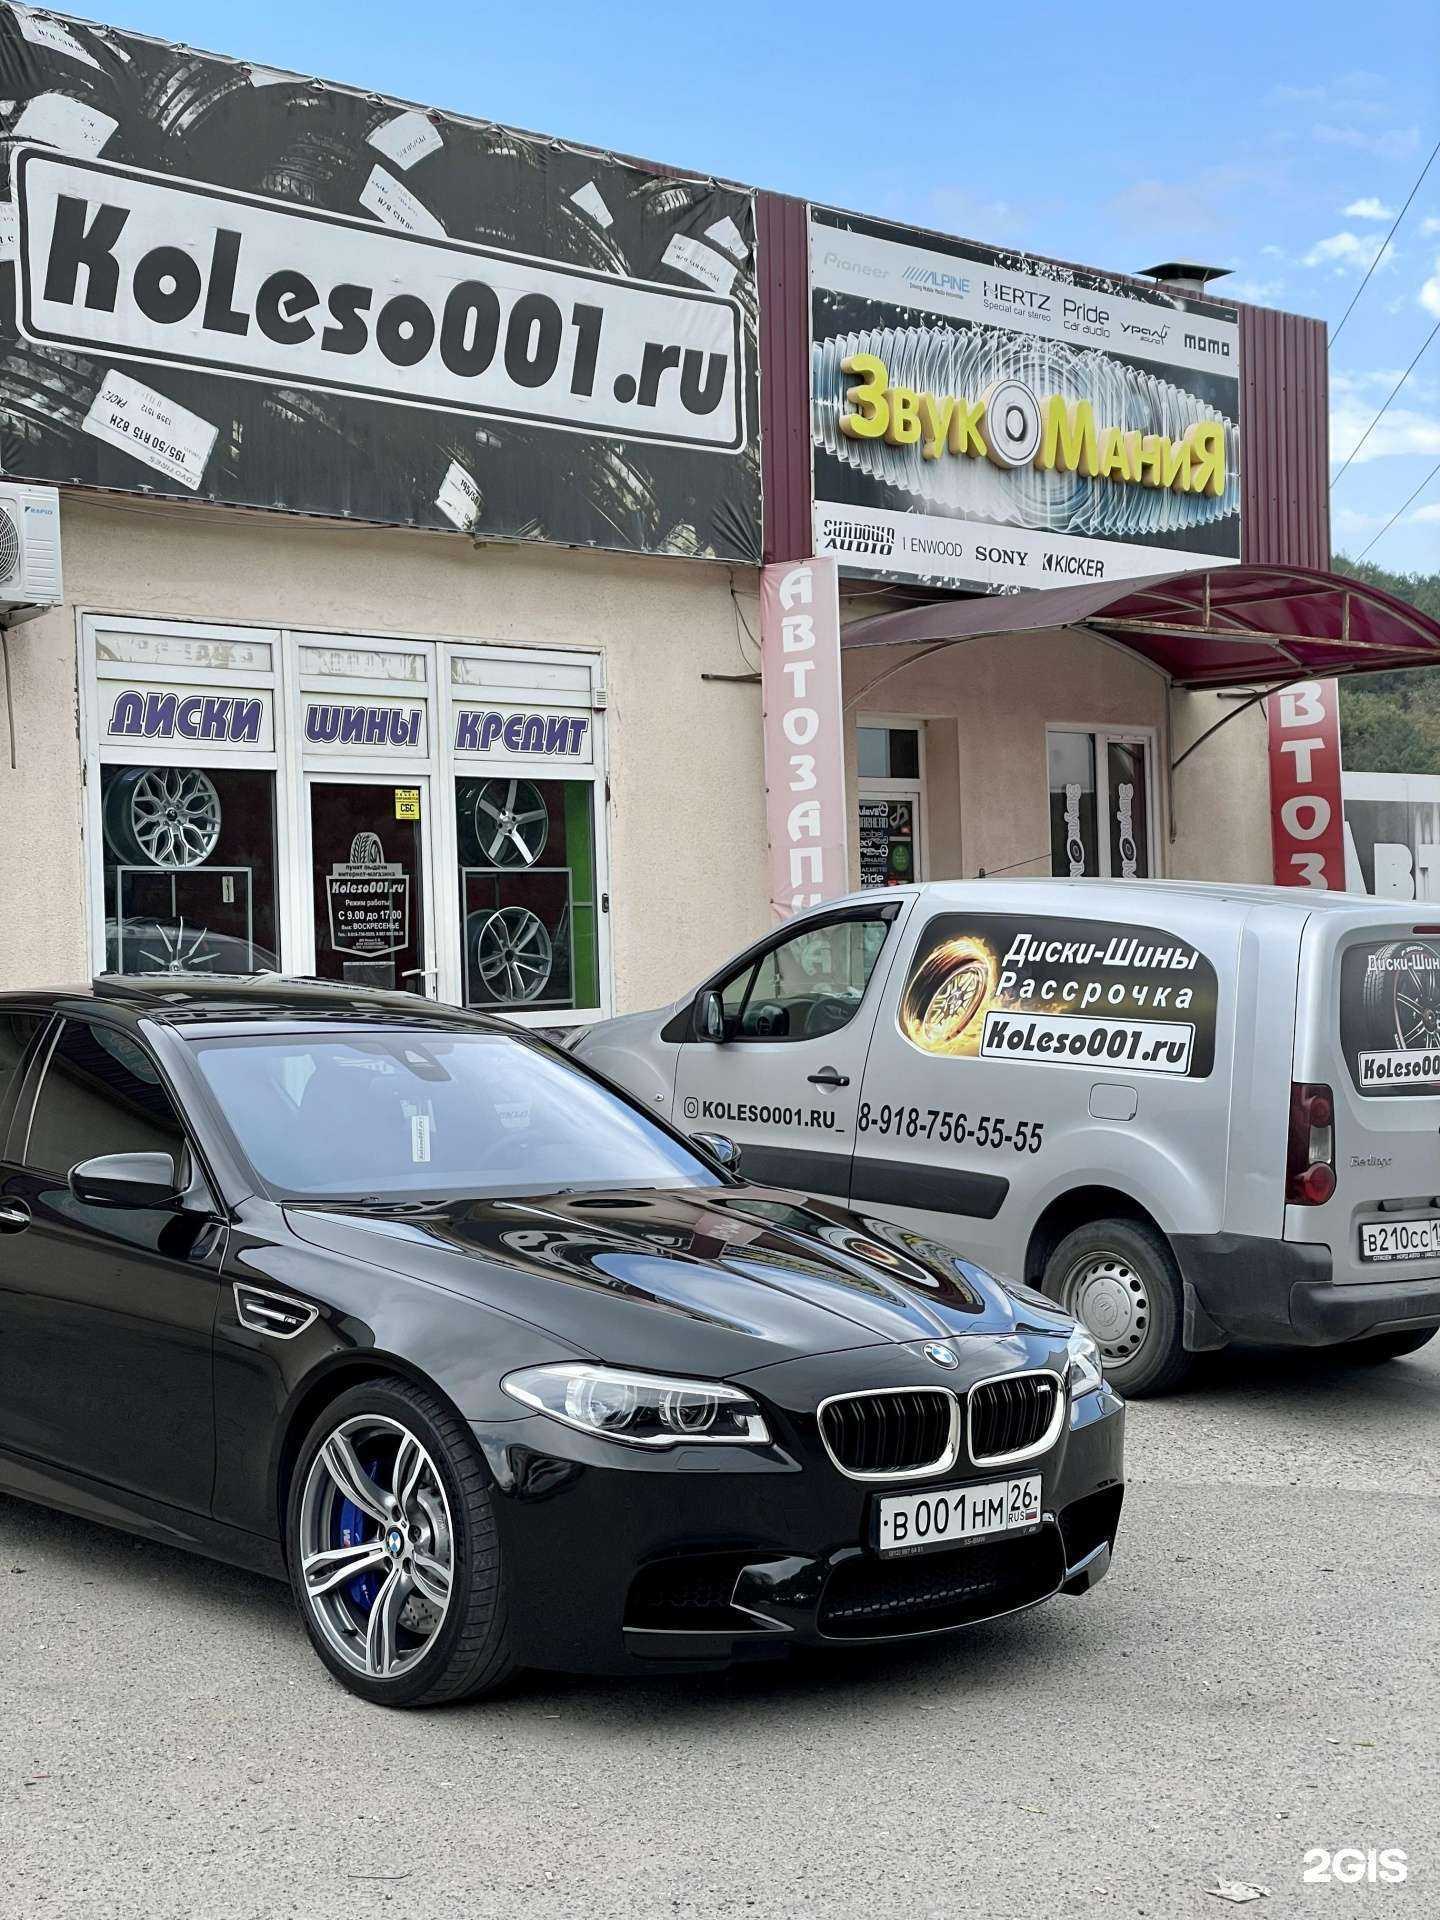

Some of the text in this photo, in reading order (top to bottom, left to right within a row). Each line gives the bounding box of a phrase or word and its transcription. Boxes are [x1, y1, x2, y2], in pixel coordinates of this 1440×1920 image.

[824, 252, 891, 279] Pioneer
[921, 269, 971, 294] ALPINE
[983, 280, 1051, 311] HERTZ
[983, 299, 1051, 321] Special car stereo
[1063, 298, 1110, 325] Pride
[1082, 325, 1110, 338] audio
[108, 413, 187, 463] 195/50 R15 82H
[824, 537, 893, 556] AUDIO
[975, 546, 1029, 567] SONY
[1054, 554, 1105, 578] KICKER
[107, 690, 263, 743] ДИСКИ
[304, 703, 422, 747] ШИНЫ
[453, 710, 590, 757] КРЕДИТ
[345, 899, 366, 907] Режим
[347, 910, 365, 920] 9.00
[366, 912, 378, 921] до
[380, 910, 402, 920] 17.00
[353, 922, 400, 930] ВОСКРЕСЕНЬЕ
[1001, 933, 1200, 970] Диски-Шины
[996, 971, 1194, 1009] Рассрочка
[858, 1102, 1045, 1154] 8-918-756-55-55
[1010, 1481, 1033, 1511] 26
[1008, 1510, 1025, 1523] RUS
